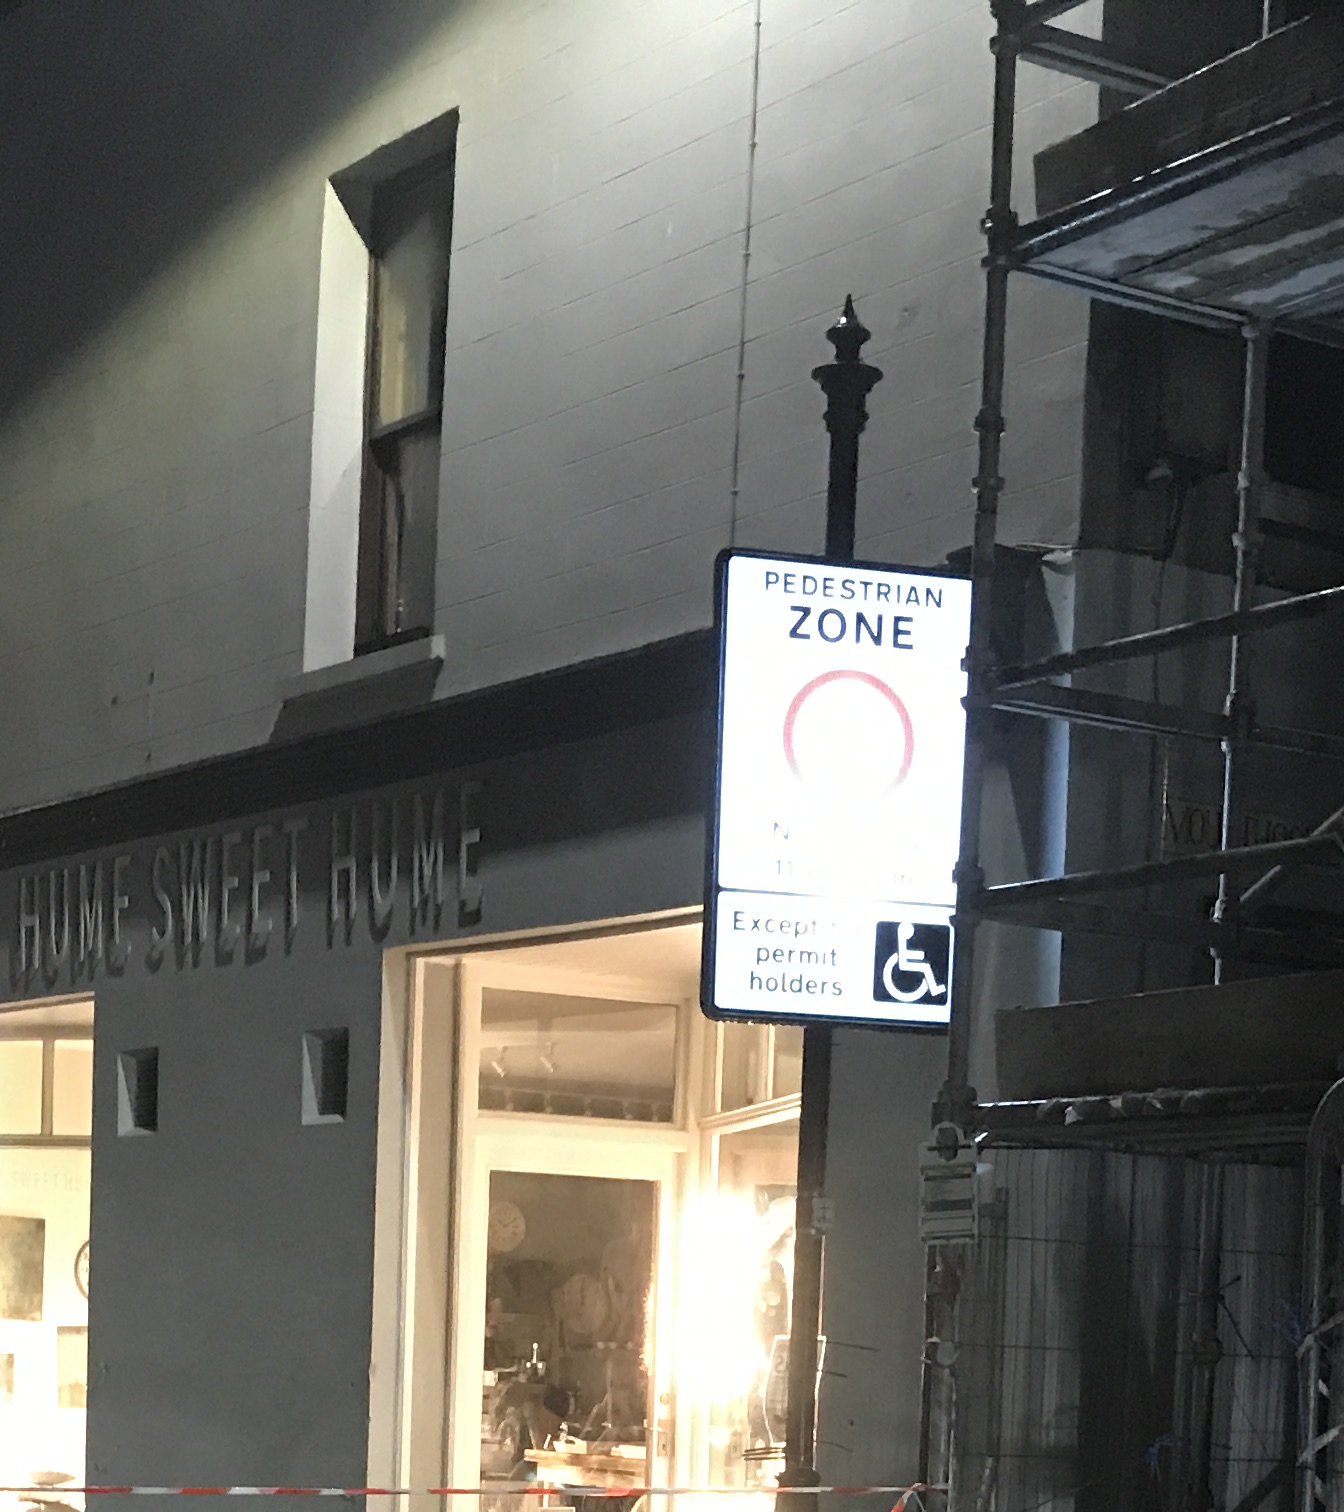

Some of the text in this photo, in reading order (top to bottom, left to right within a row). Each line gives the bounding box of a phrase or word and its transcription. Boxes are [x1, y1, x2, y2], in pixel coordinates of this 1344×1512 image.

[765, 571, 943, 609] PEDESTRIAN
[788, 605, 915, 650] ZONE
[151, 818, 308, 954] SWEET
[755, 946, 839, 966] permit
[749, 971, 844, 996] holders
